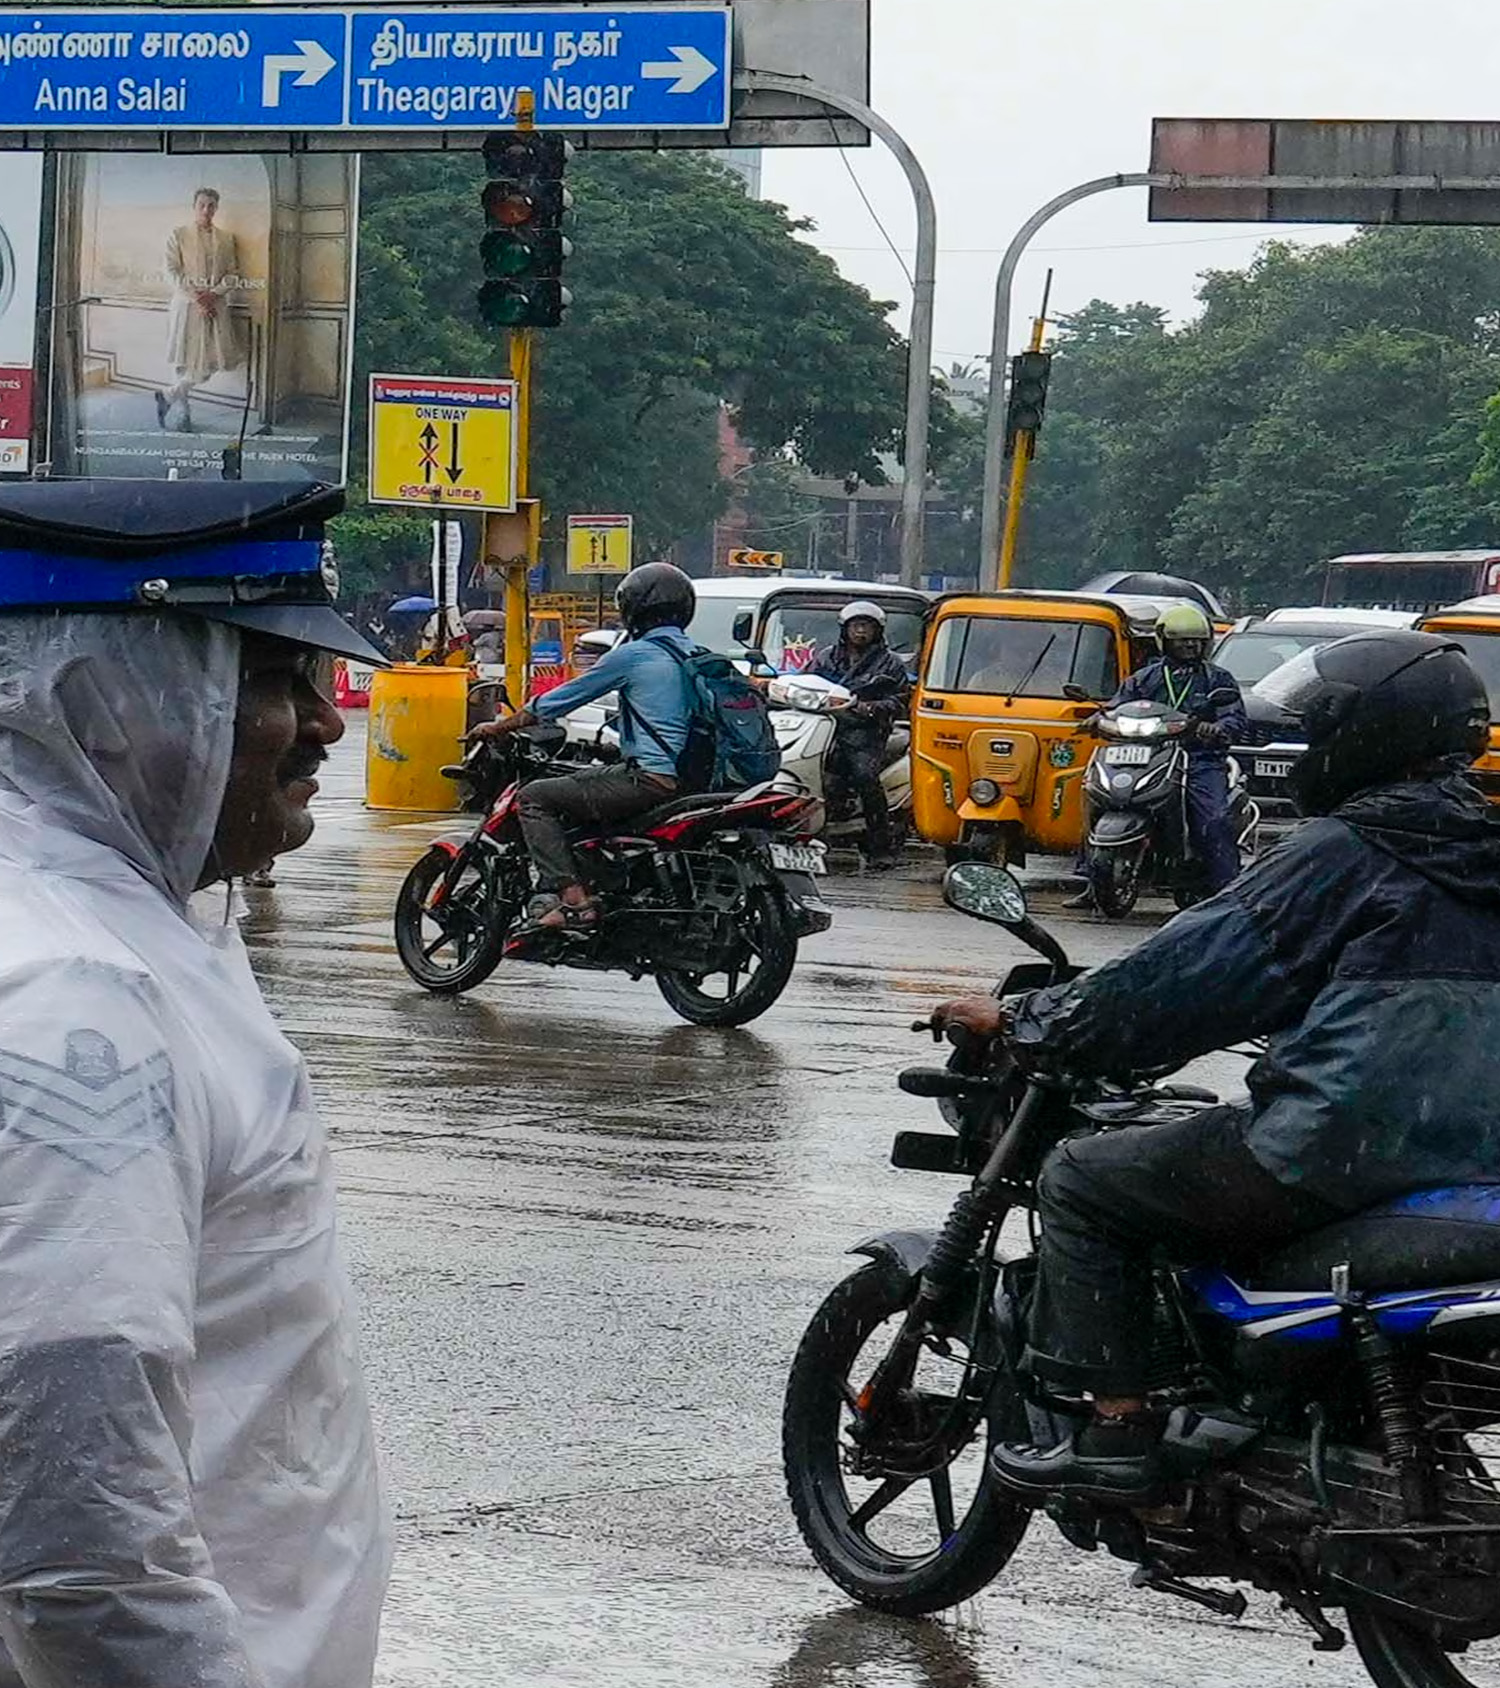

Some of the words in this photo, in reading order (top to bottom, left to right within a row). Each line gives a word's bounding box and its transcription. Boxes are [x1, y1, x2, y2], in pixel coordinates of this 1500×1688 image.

[140, 28, 250, 60] சாலை
[369, 19, 543, 71] தியாகராய
[552, 19, 623, 71] நகர்
[35, 79, 111, 111] Anna
[118, 78, 187, 111] Salai
[544, 79, 633, 118] Nagar
[415, 407, 438, 420] ONE
[440, 409, 467, 421] WAY
